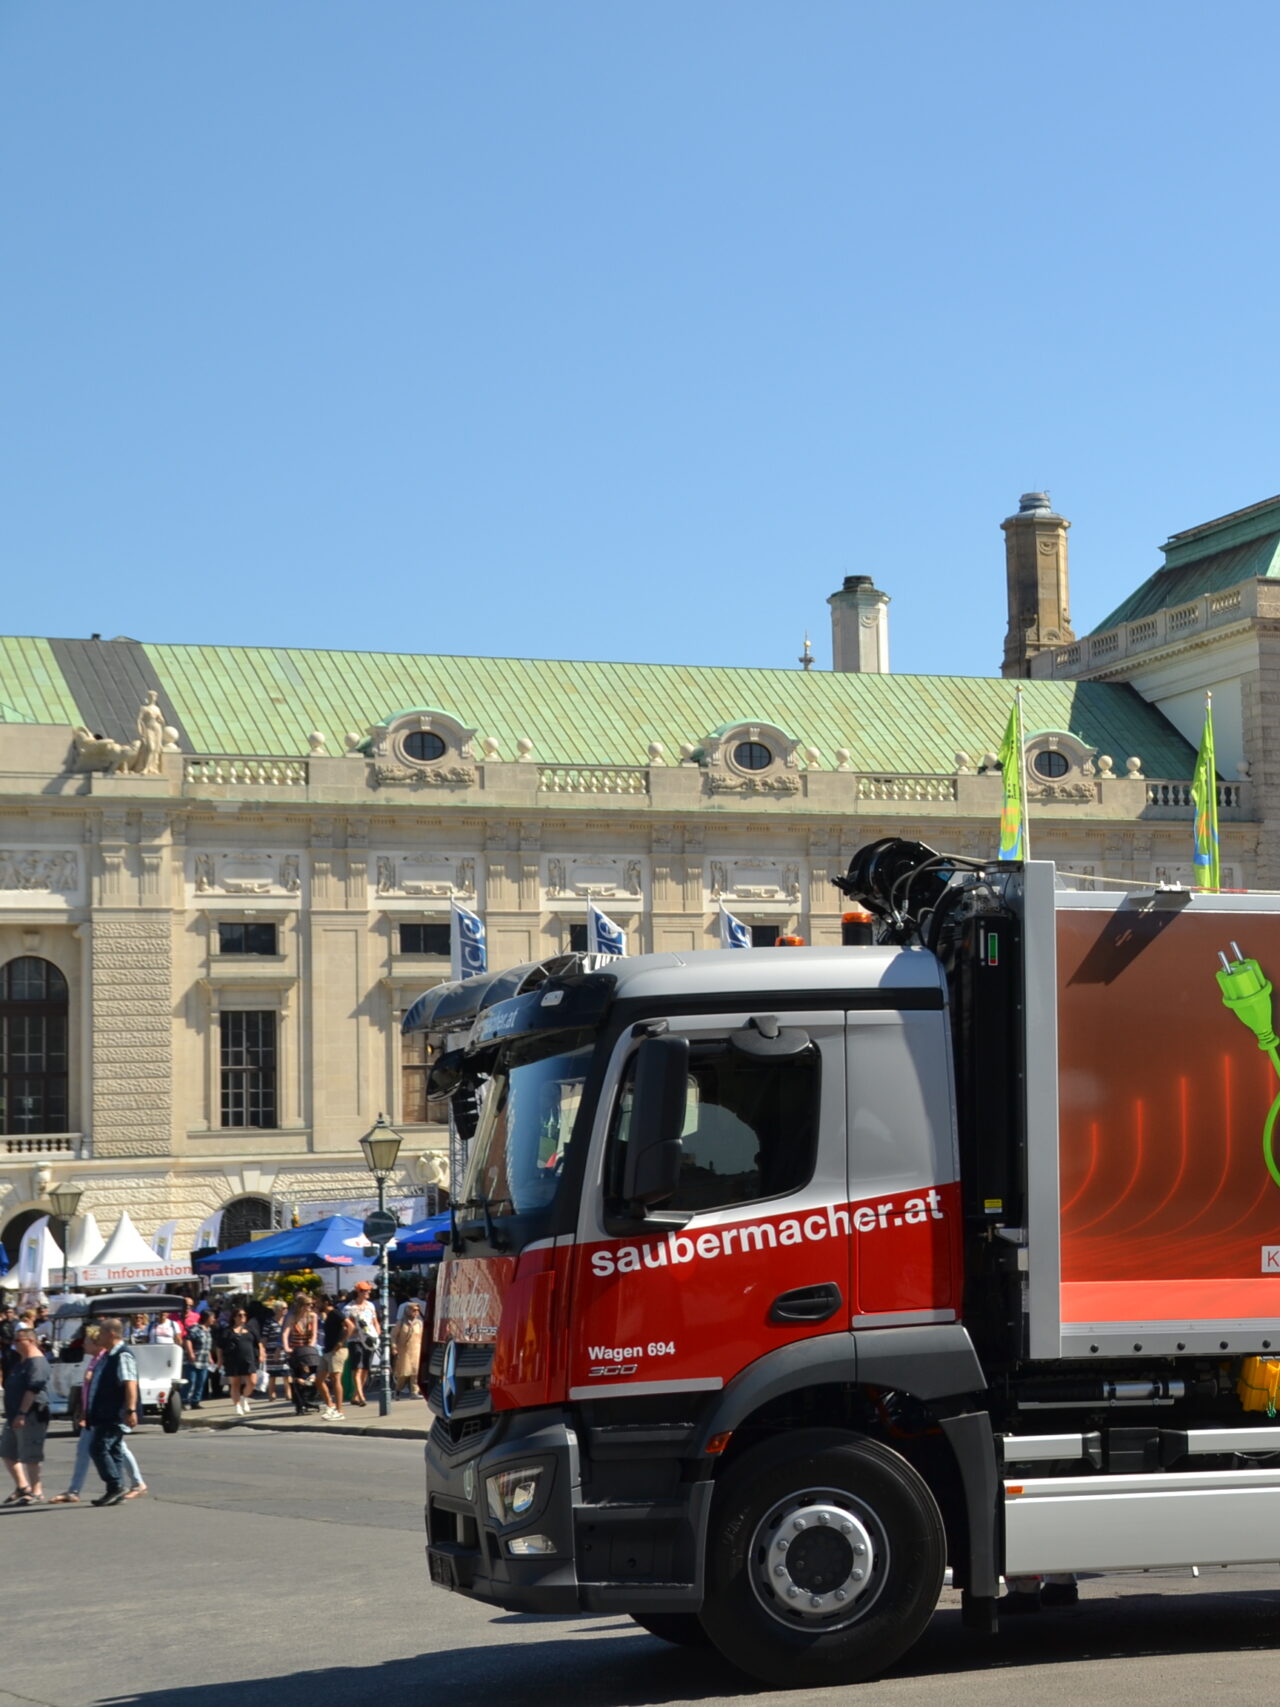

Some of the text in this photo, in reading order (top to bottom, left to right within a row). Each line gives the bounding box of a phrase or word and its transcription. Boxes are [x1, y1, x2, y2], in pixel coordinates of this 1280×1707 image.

[591, 1189, 945, 1277] saubermacher.at
[107, 1264, 193, 1280] Information
[588, 1341, 676, 1362] Wagen 694
[588, 1364, 638, 1376] 300
